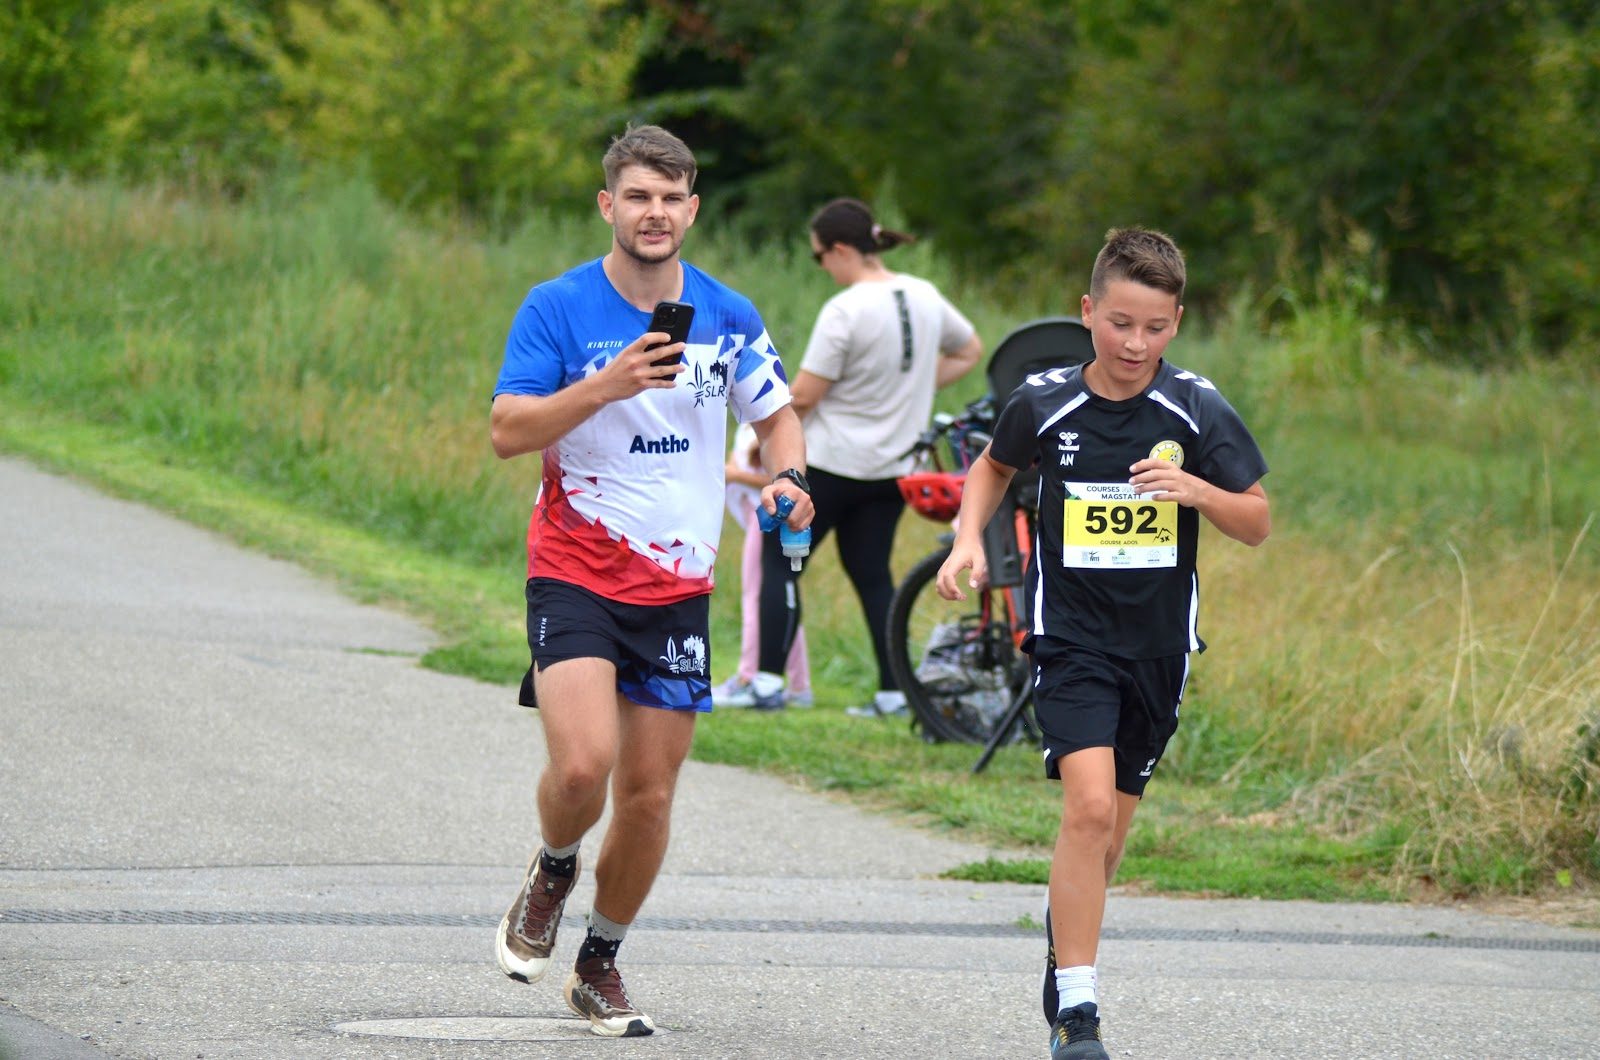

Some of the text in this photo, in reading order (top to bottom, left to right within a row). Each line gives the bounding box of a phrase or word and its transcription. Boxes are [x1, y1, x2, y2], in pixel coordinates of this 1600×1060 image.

[587, 340, 624, 349] KINETIK
[704, 385, 728, 399] SLR
[629, 434, 689, 453] Antho
[1060, 453, 1074, 466] AN
[1086, 485, 1120, 493] COURSES
[1085, 506, 1158, 535] 592
[1160, 535, 1170, 543] 3K
